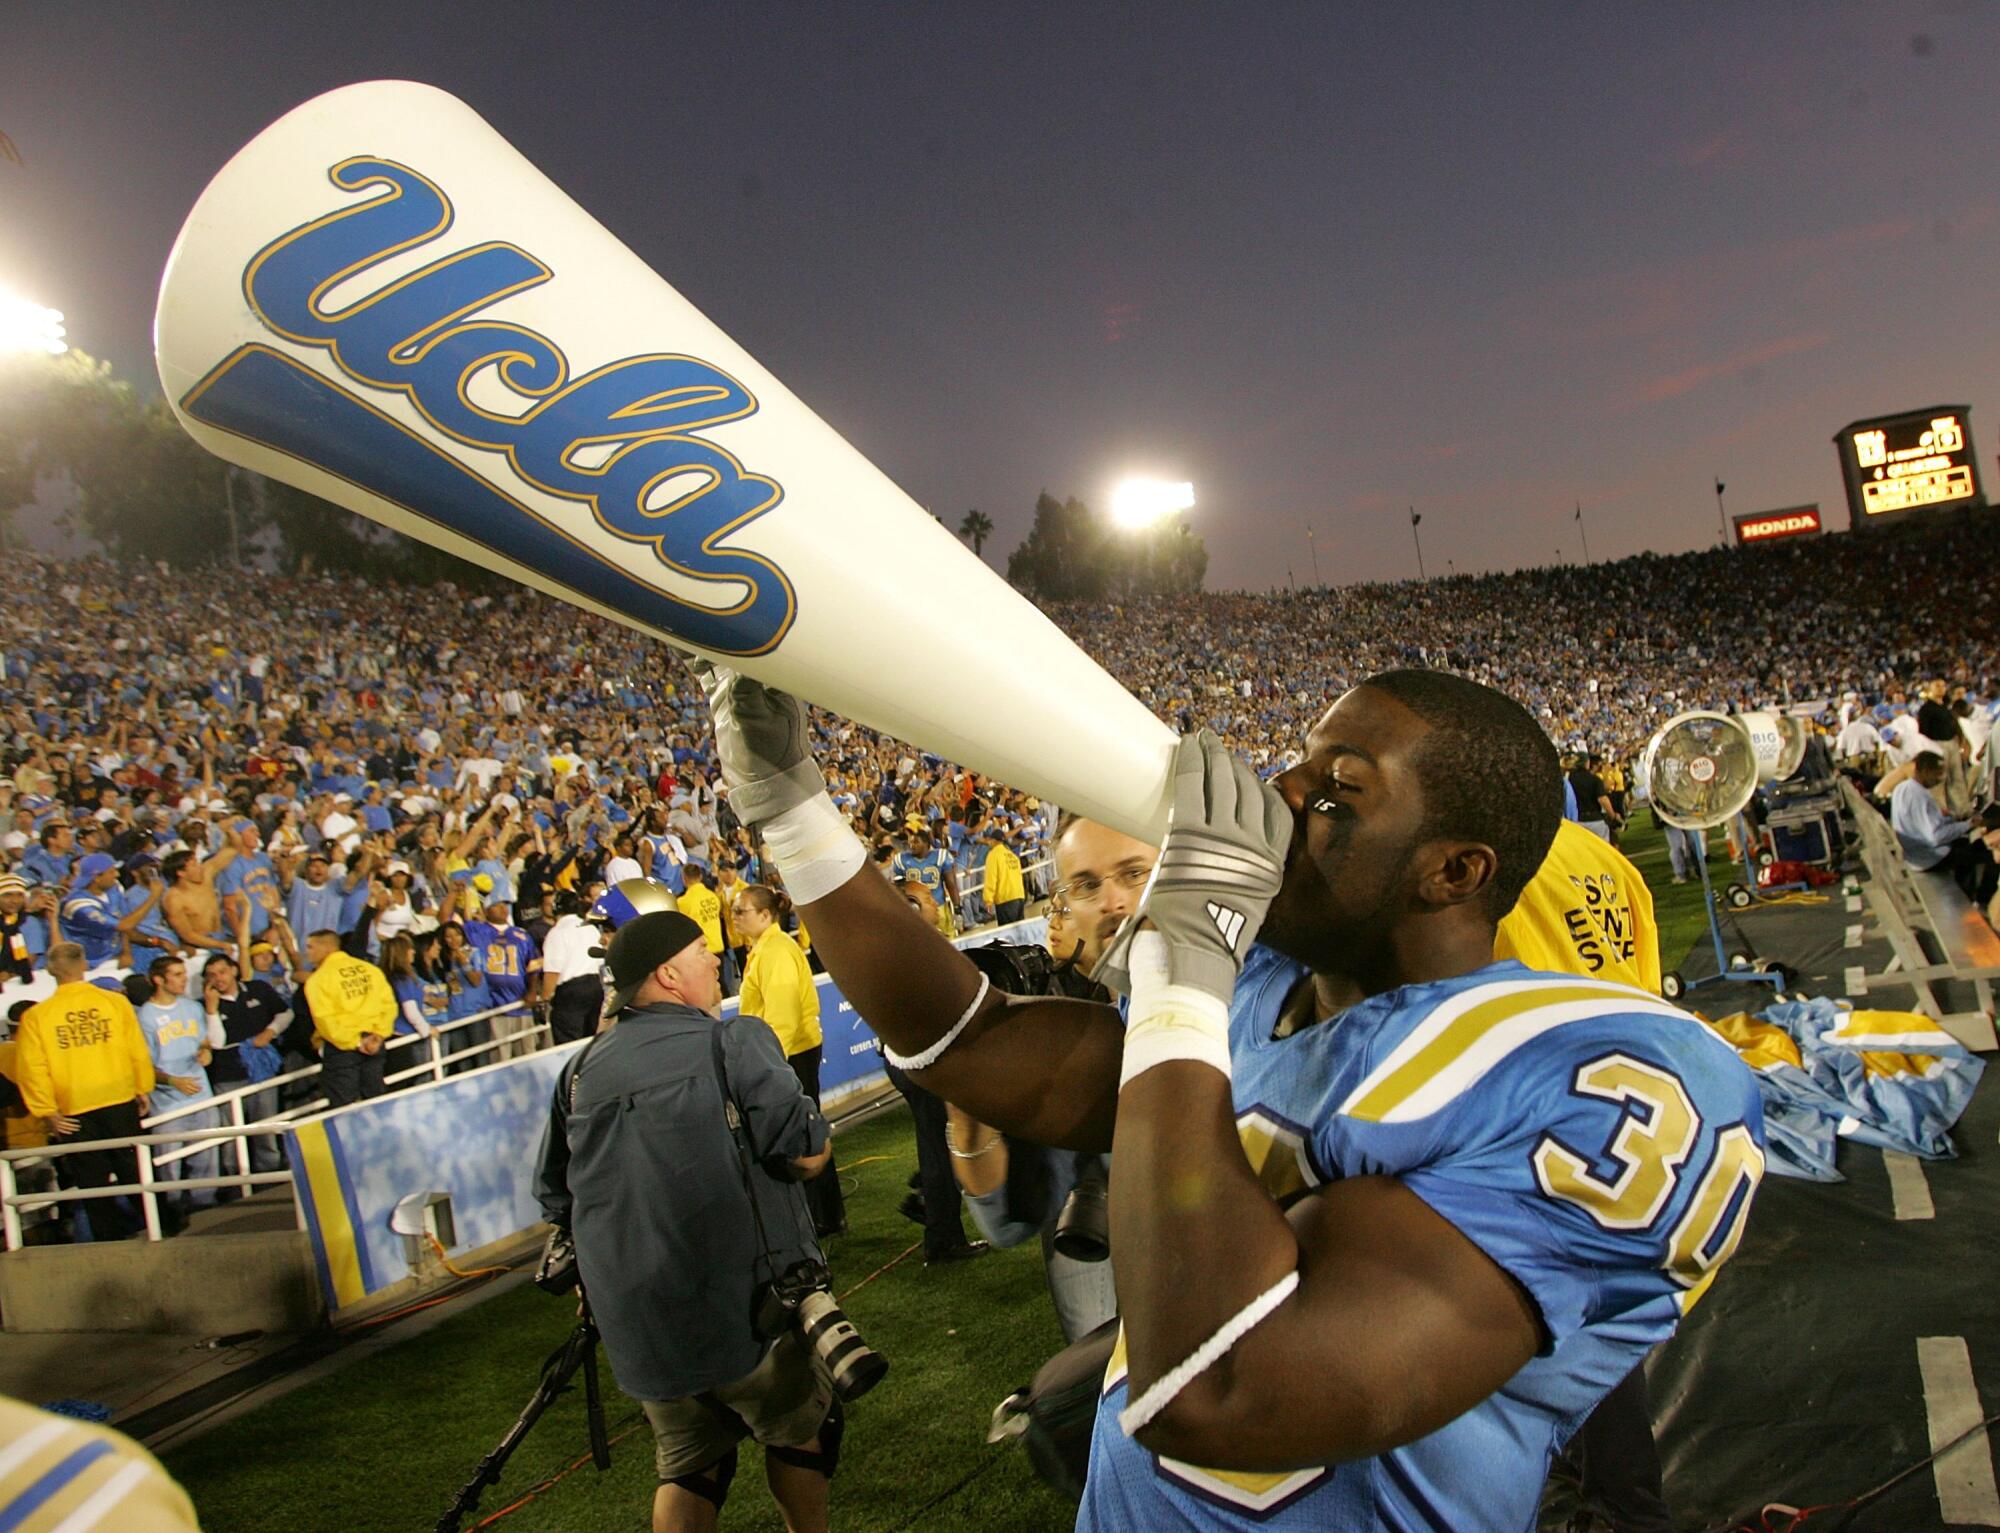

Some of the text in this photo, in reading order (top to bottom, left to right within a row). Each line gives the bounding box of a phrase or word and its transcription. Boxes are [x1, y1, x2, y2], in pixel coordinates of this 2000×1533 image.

[1742, 515, 1817, 538] HONDA
[1752, 733, 1777, 744] BIG
[487, 943, 519, 976] 21
[339, 965, 366, 978] CSC
[65, 1008, 100, 1023] CSC
[56, 1018, 112, 1038] EVENT
[58, 1031, 113, 1050] STAFF
[1530, 1049, 1766, 1289] 30
